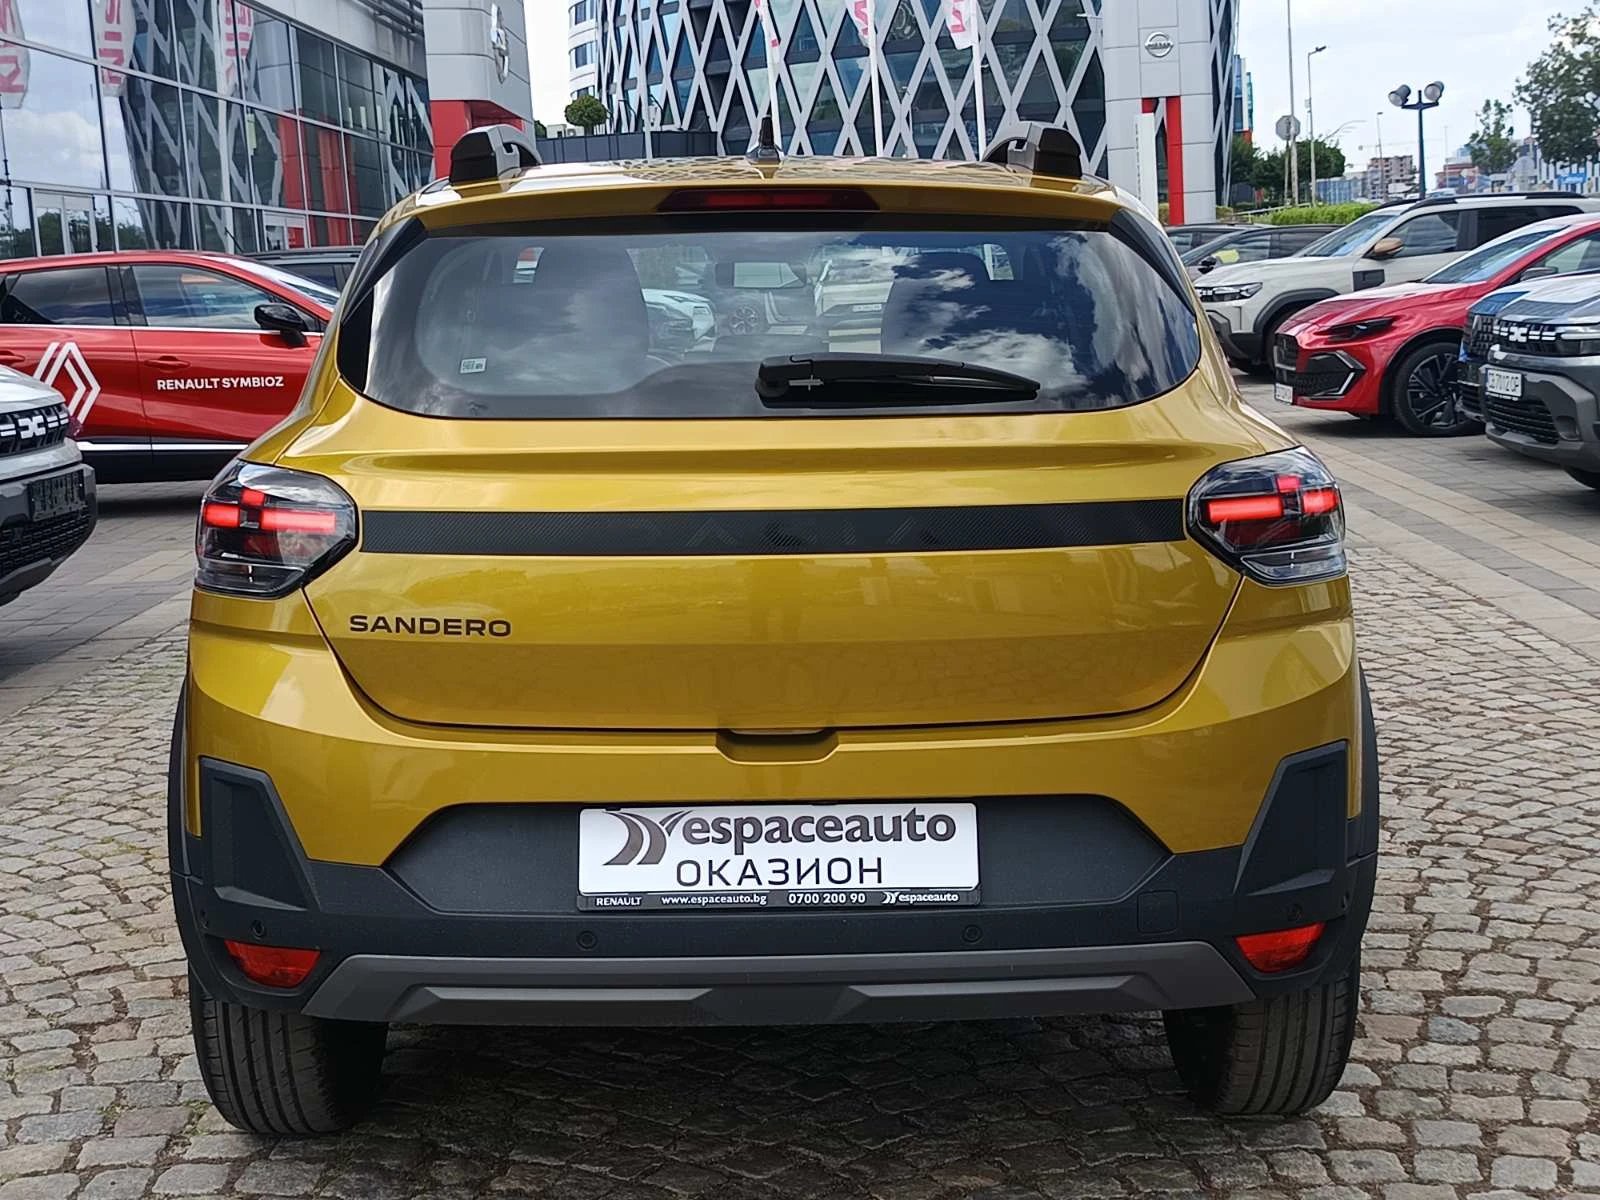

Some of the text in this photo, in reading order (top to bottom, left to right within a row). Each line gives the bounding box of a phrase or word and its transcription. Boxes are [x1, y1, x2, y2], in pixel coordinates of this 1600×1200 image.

[157, 376, 285, 390] RENAULT SYMBIOZ
[350, 615, 511, 637] SANDERO
[682, 807, 957, 855] espaceauto
[676, 857, 883, 886] ОКАЗИОН
[596, 892, 959, 906] RENAULT www.espaceauto.bg 0700 200 90 espaceauto
